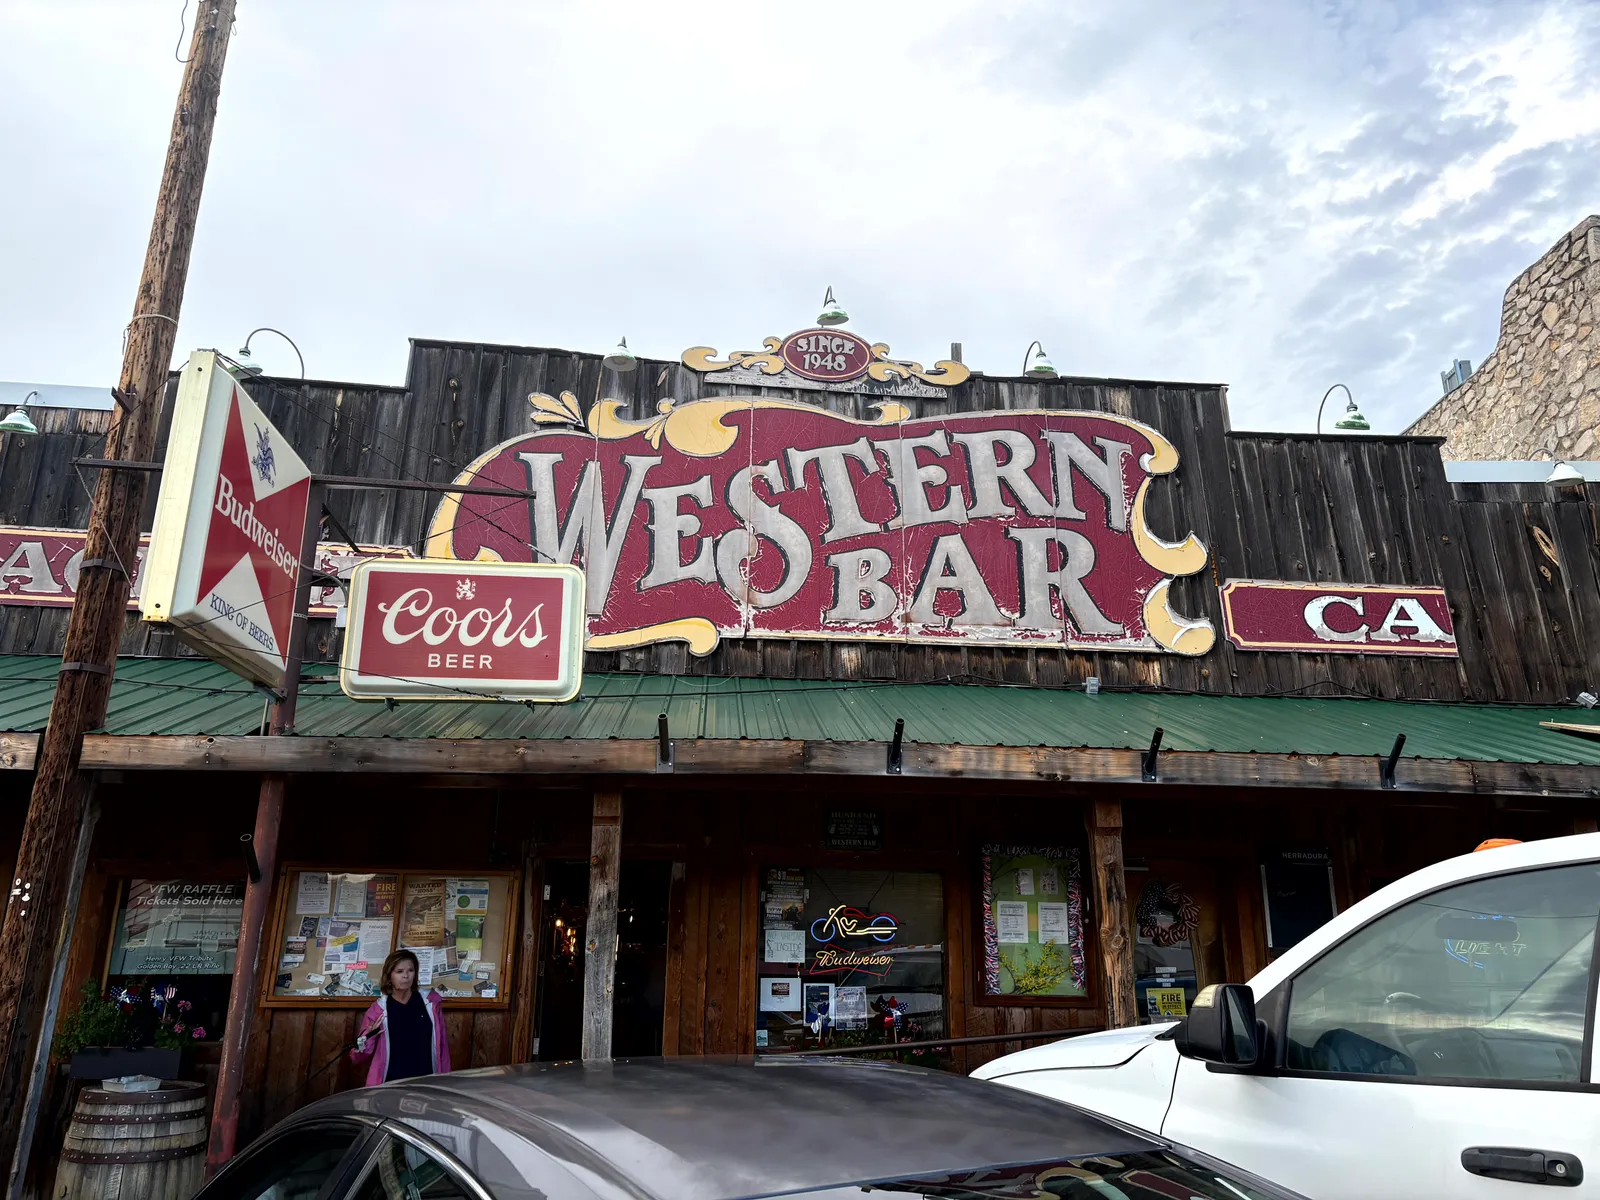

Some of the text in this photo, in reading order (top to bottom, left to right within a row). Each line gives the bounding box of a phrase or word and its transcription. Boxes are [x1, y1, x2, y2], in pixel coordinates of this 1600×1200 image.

[797, 336, 855, 355] SINCE
[803, 353, 847, 371] 1948
[215, 474, 299, 580] Budweiser
[516, 429, 1132, 617] WESTERN
[822, 526, 1125, 635] BAR
[209, 593, 275, 651] KING OF BEERS
[377, 588, 549, 649] Coors
[427, 653, 493, 669] BEER
[1282, 852, 1329, 860] HERRADURA
[149, 884, 235, 894] VFW RAFFLE
[376, 883, 396, 892] FIRE
[137, 896, 243, 906] Tickets Sold Here
[816, 950, 894, 966] Budweiser
[1161, 993, 1181, 1002] FIRE
